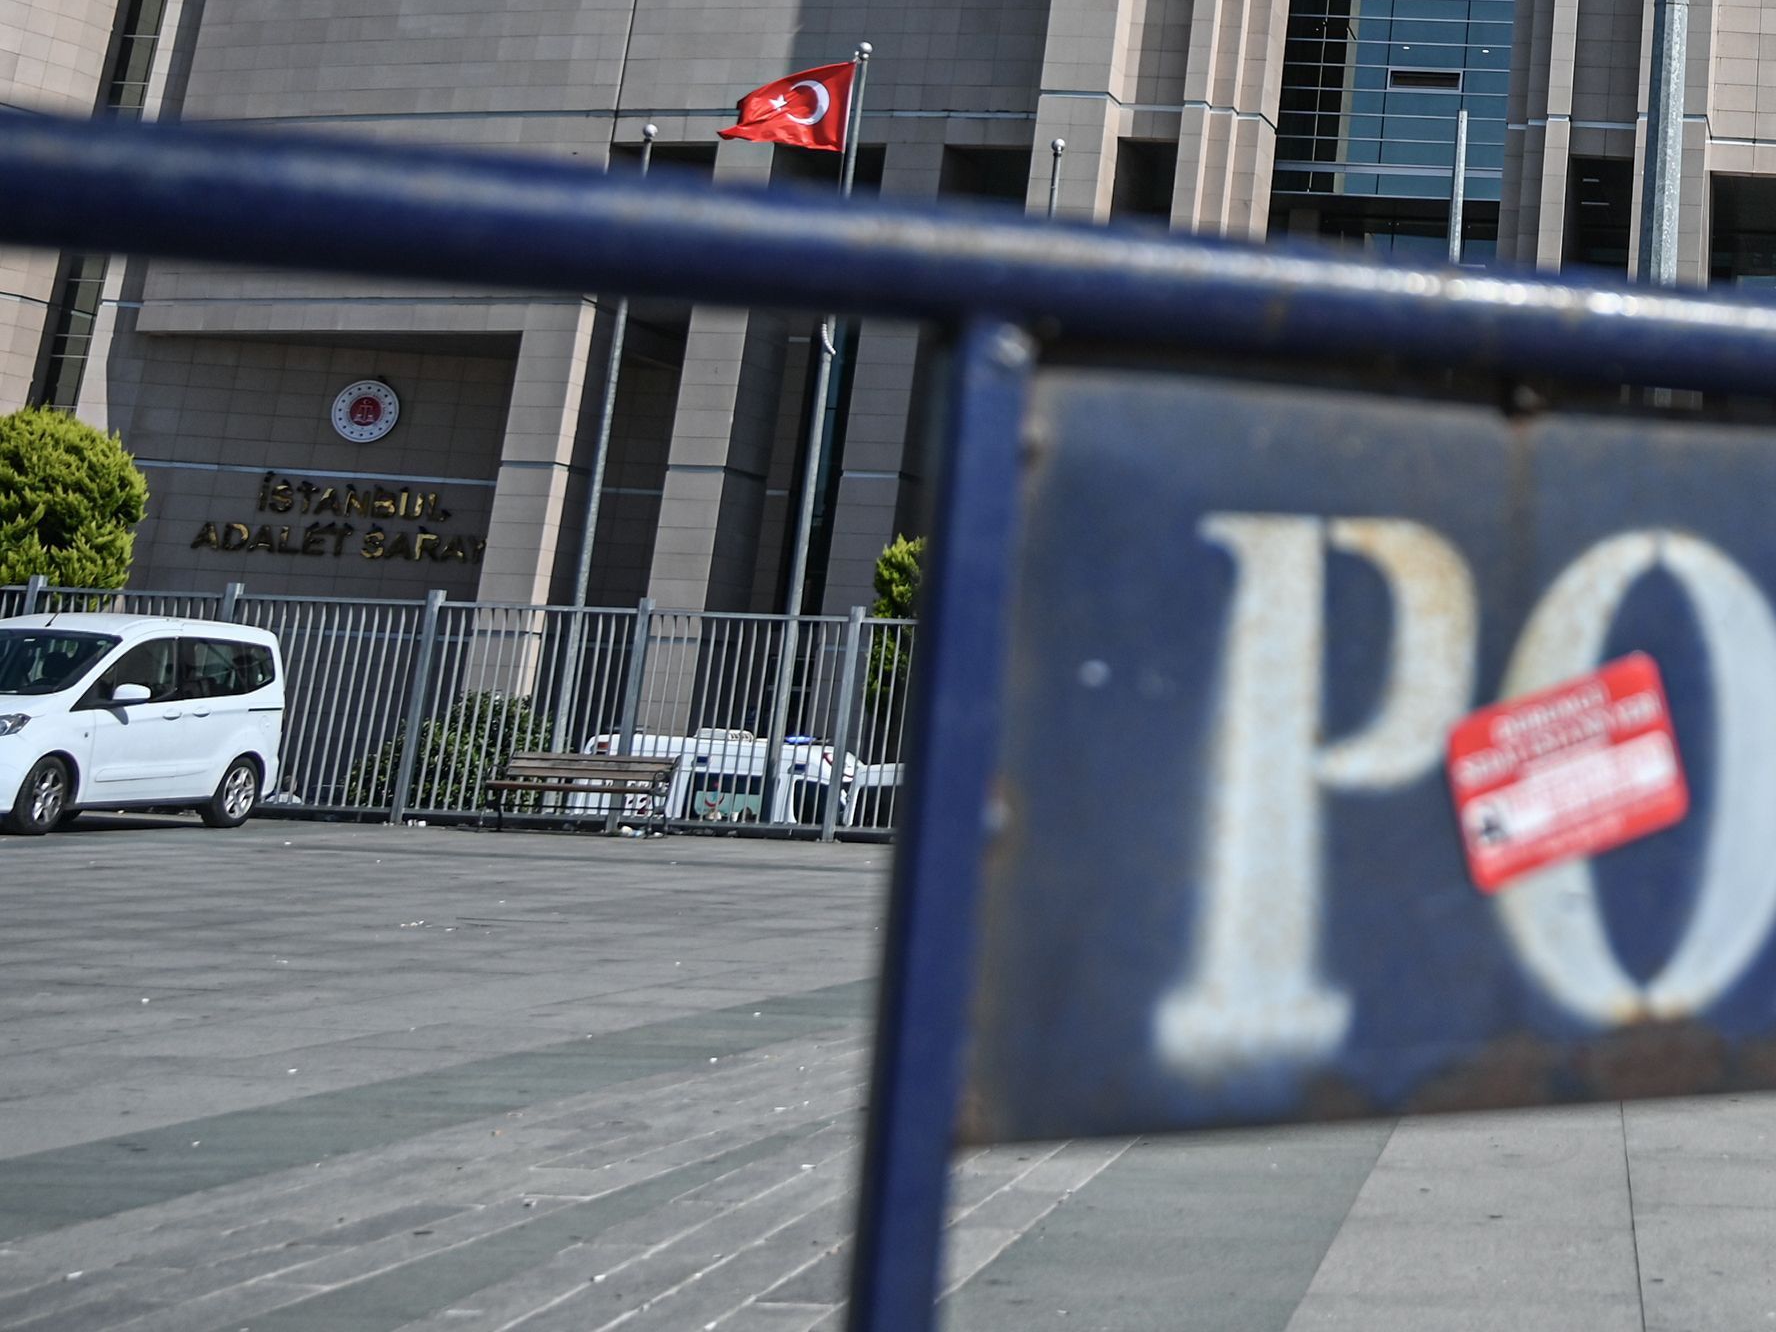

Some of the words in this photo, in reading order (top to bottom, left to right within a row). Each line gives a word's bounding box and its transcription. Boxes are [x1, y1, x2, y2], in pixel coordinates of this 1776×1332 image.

[257, 471, 450, 521] İSTANBUL
[190, 522, 353, 557] ADALET
[360, 529, 487, 565] SARAY
